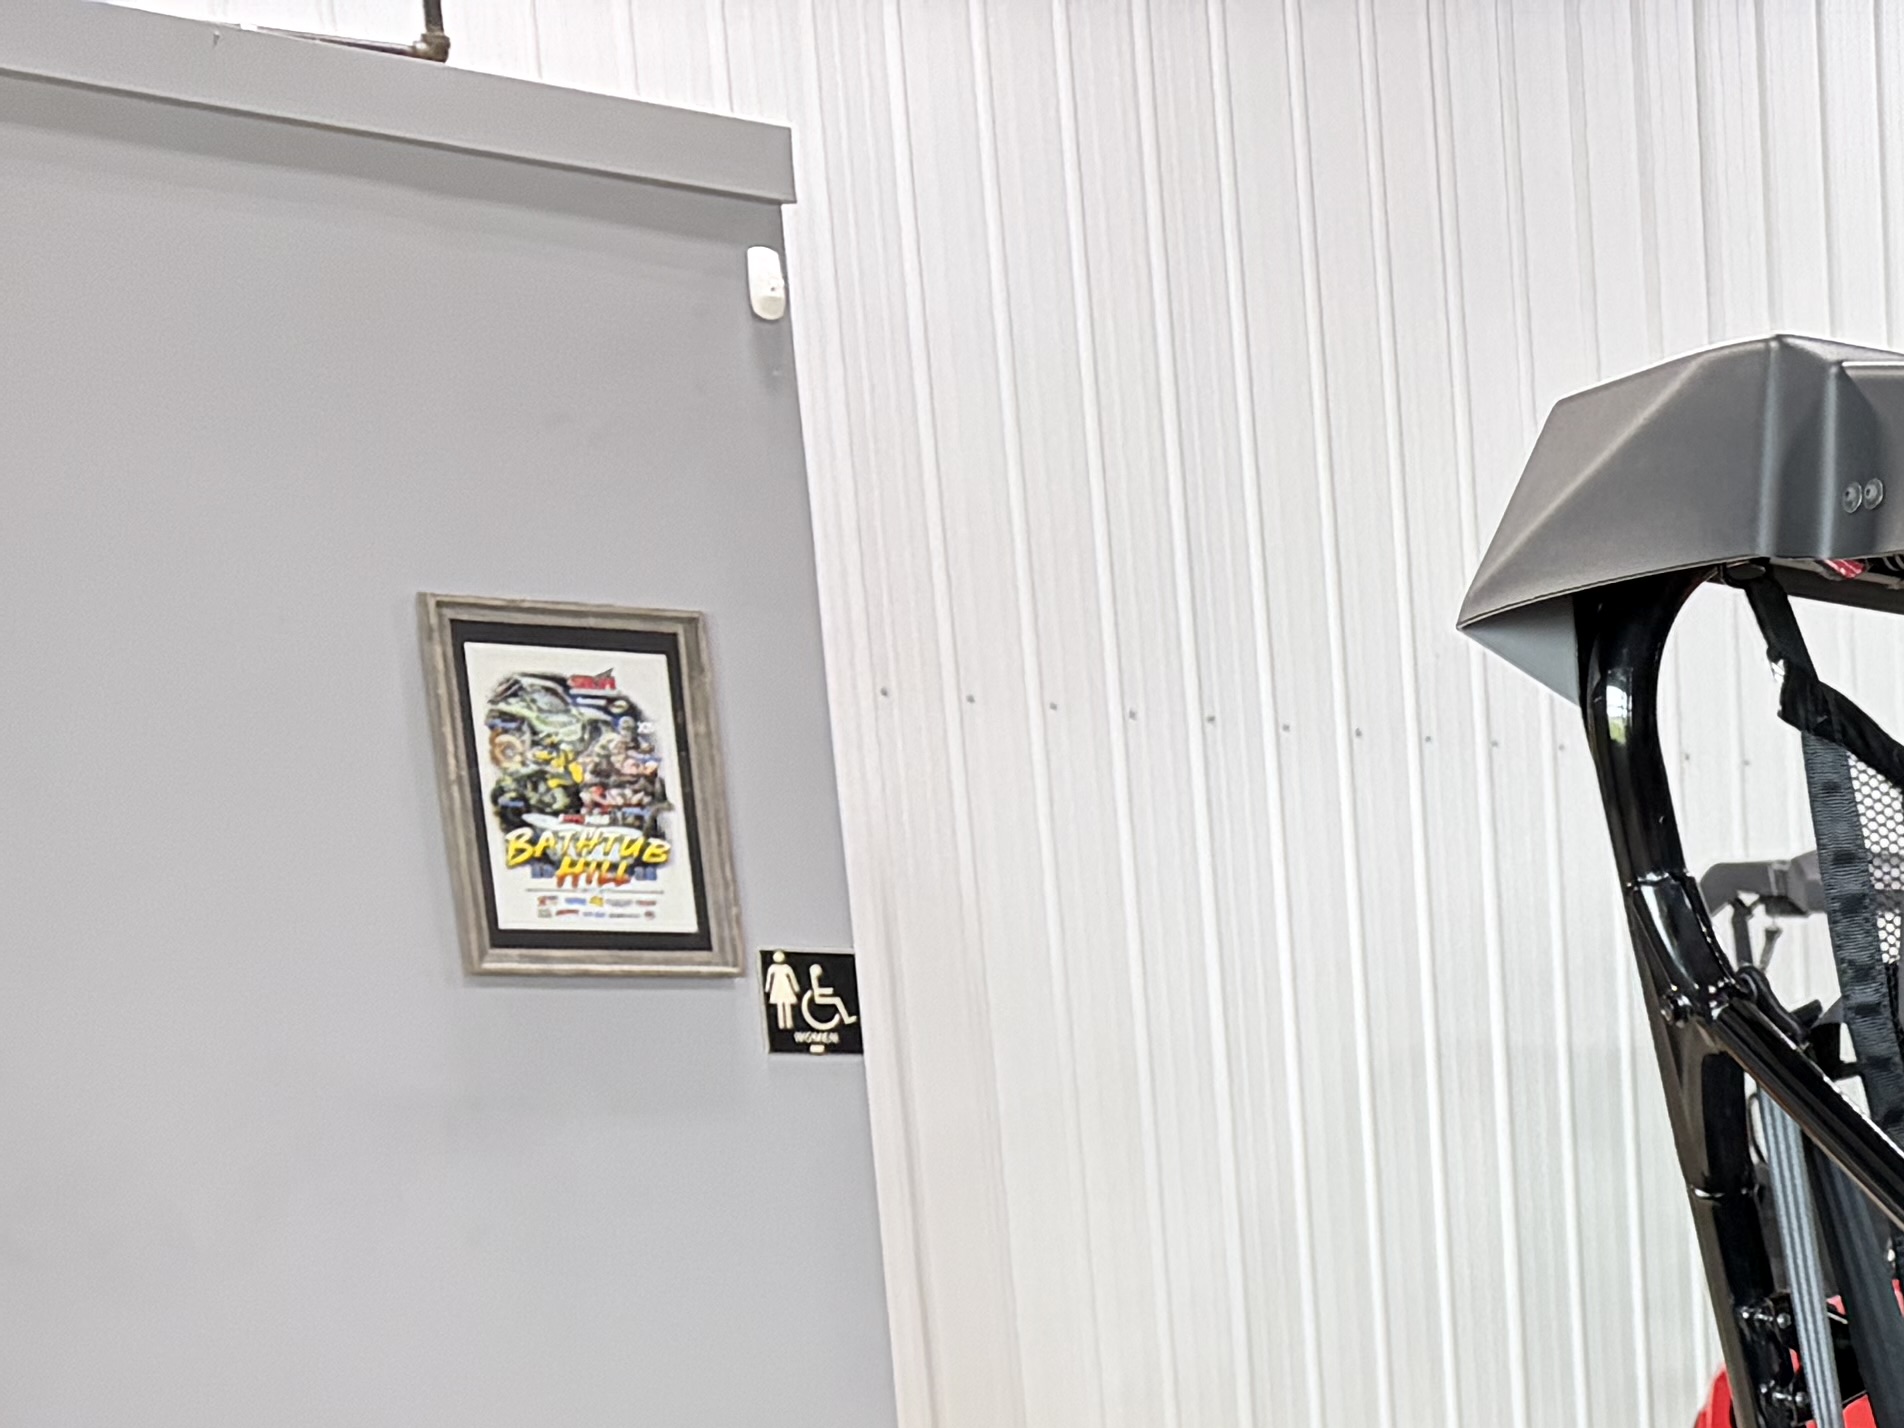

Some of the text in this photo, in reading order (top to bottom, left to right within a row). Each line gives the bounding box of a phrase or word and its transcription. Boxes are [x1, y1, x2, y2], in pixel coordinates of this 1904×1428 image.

[505, 827, 671, 868] BATHTUB
[554, 856, 632, 888] HILL
[794, 1031, 839, 1044] WOMEN
